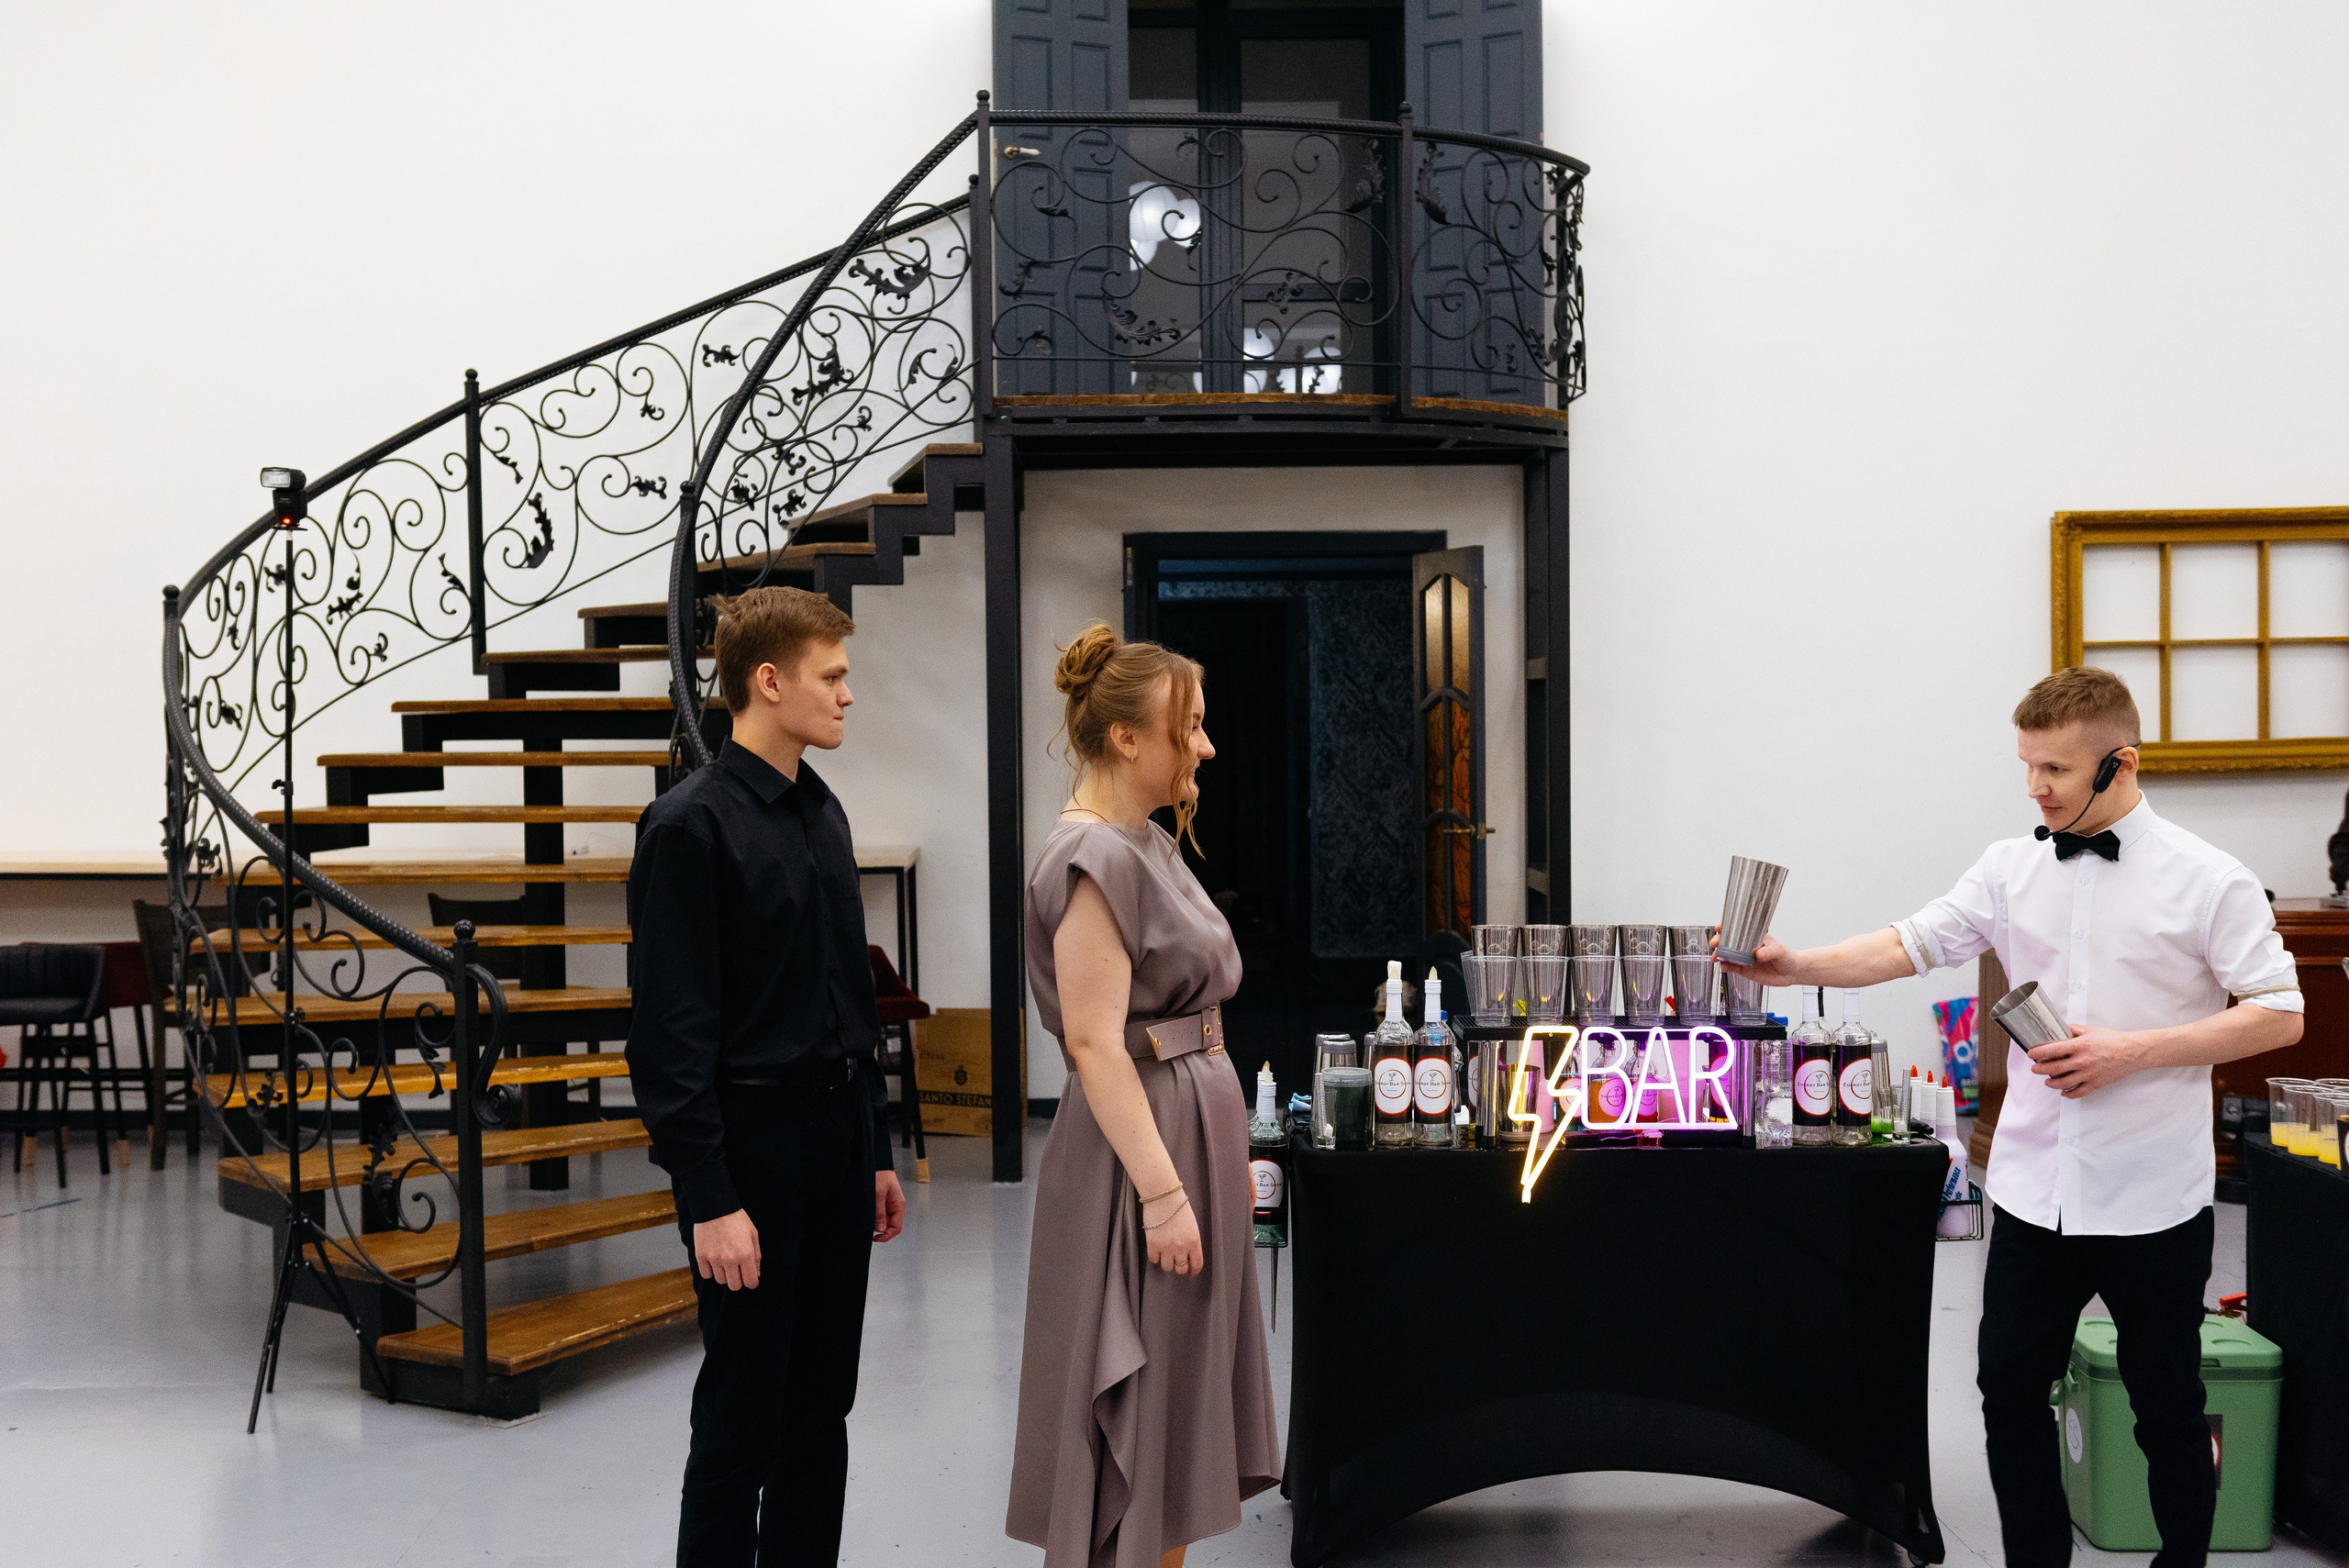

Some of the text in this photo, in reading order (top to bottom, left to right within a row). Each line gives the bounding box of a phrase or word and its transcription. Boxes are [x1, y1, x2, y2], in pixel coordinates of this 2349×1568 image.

[1582, 1026, 1738, 1129] BAR
[918, 1091, 992, 1107] SANTO STEFAN
[1943, 1166, 1962, 1199] Performance
